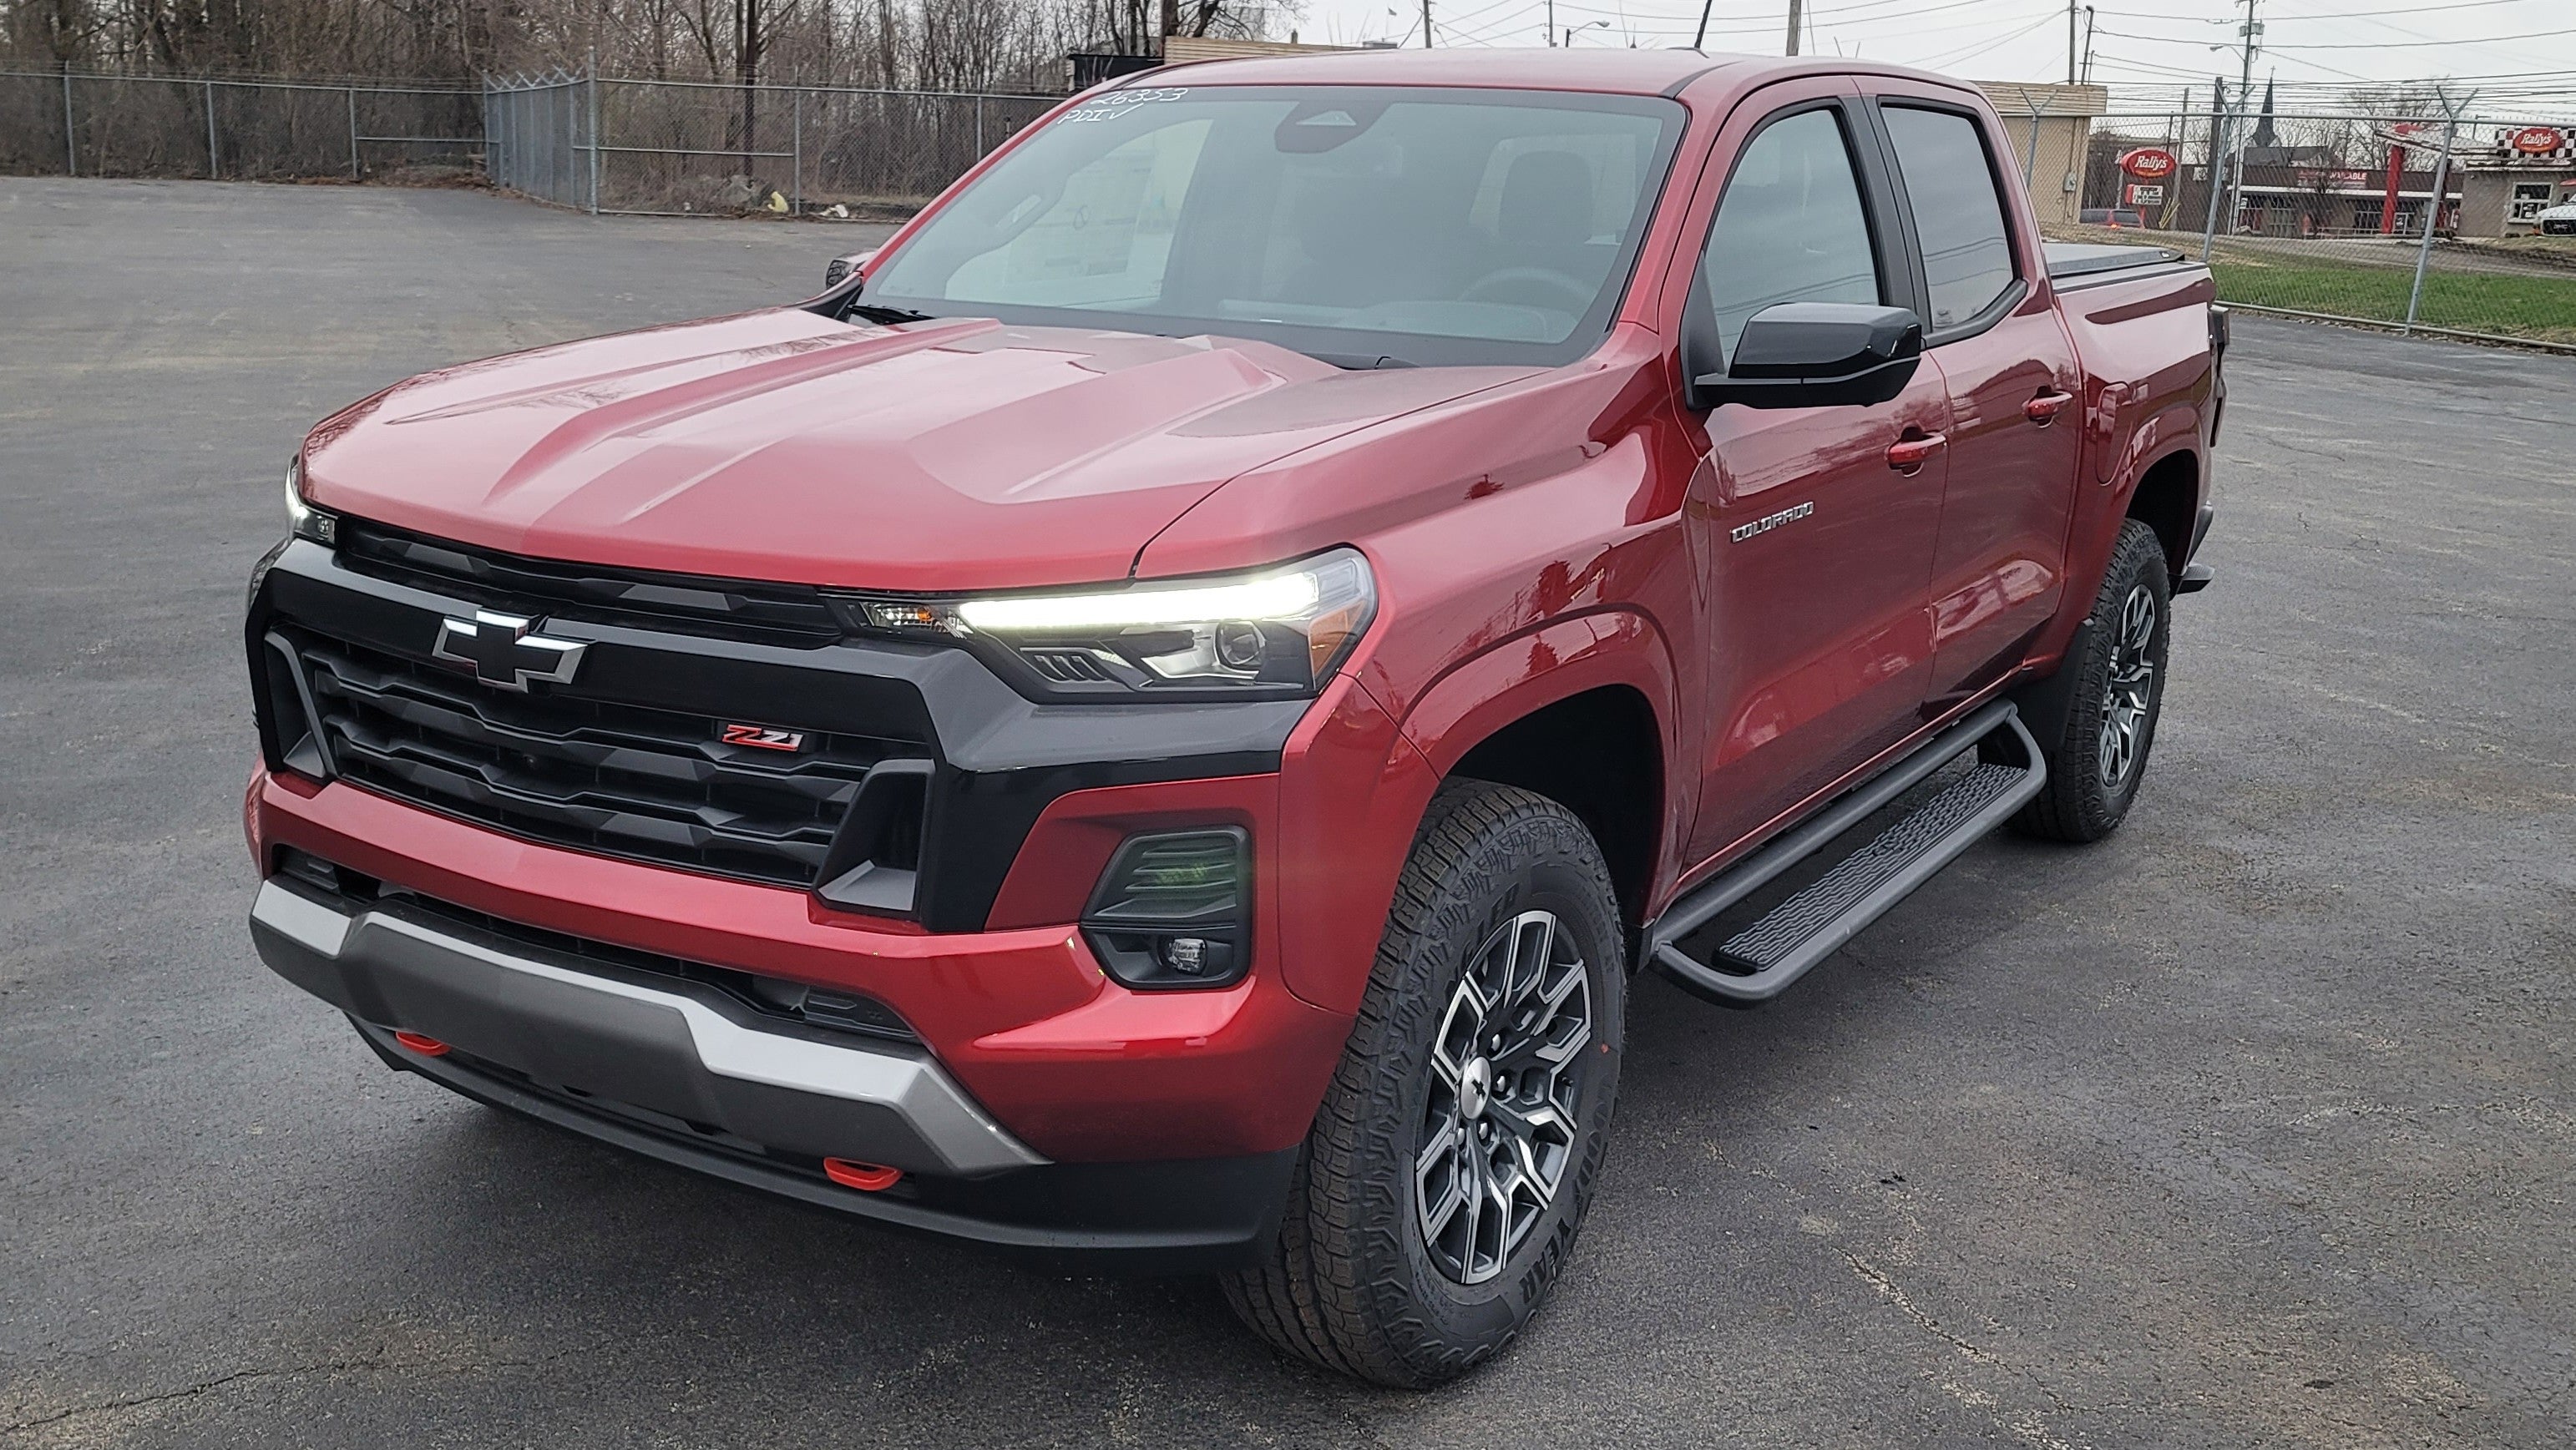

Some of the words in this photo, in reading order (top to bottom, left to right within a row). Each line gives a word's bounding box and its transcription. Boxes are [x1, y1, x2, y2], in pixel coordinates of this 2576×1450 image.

[1091, 88, 1188, 104] 26353
[2521, 134, 2553, 146] Rally's
[2134, 155, 2168, 170] Rally's
[1730, 501, 1814, 543] COLORADO
[722, 724, 803, 751] Z71
